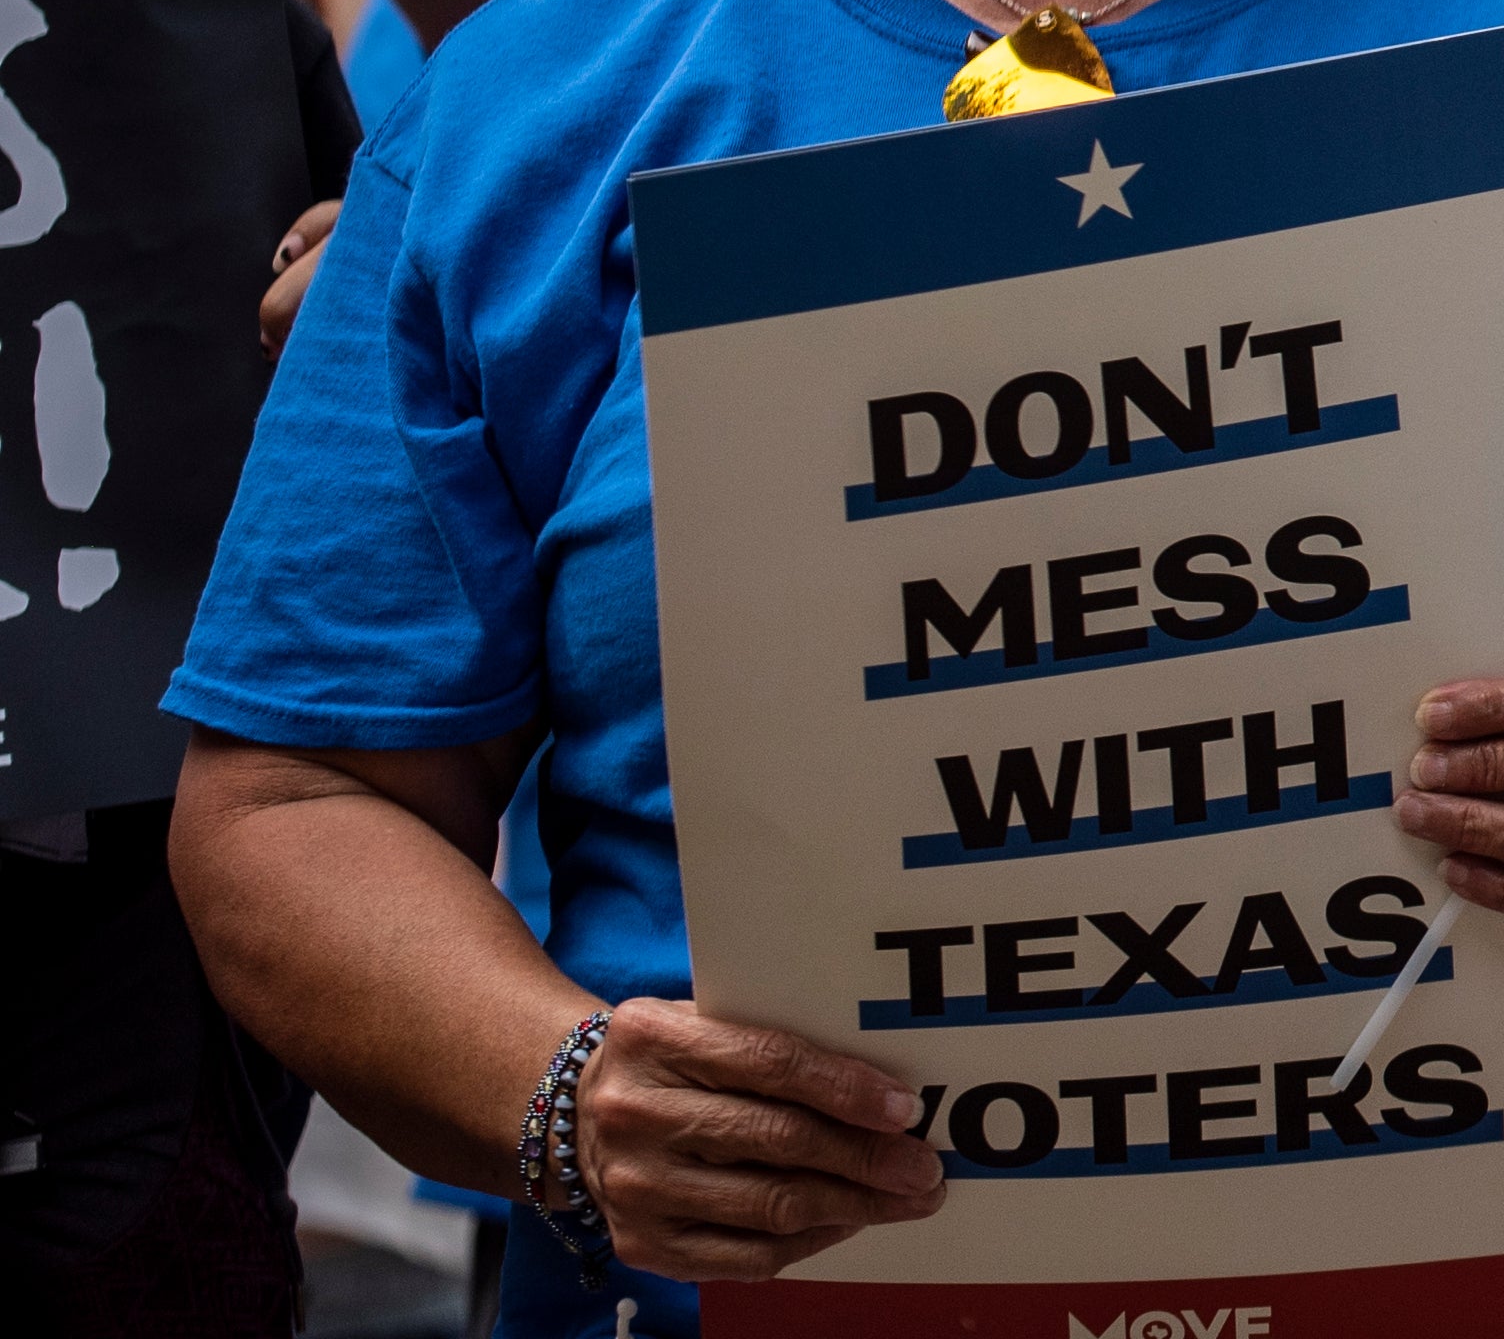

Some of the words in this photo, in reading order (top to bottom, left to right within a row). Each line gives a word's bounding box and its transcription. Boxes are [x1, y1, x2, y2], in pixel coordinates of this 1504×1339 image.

[865, 321, 1342, 504] DON'T
[900, 515, 1371, 681] MESS
[936, 699, 1351, 851] WITH
[875, 875, 1429, 1018] TEXAS
